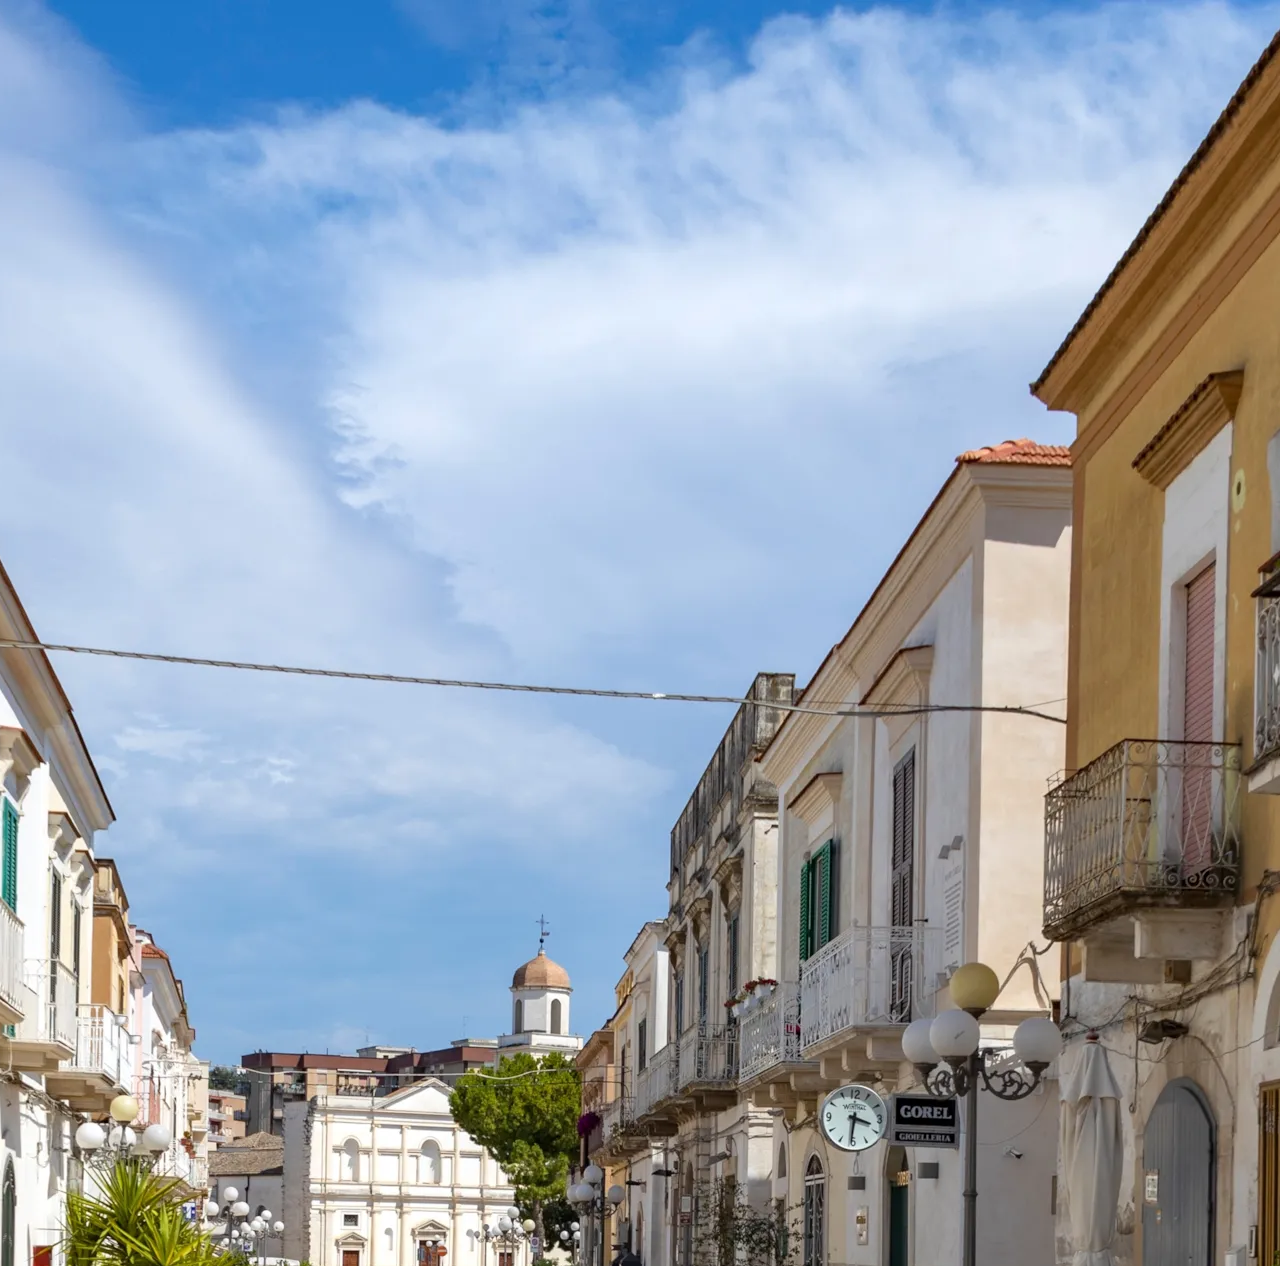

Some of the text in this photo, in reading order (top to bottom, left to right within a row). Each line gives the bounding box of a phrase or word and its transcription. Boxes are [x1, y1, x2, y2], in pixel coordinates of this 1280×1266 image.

[850, 1089, 861, 1100] 12
[825, 1112, 832, 1121] 9
[900, 1105, 952, 1120] GOREL
[876, 1115, 883, 1124] 3
[898, 1132, 951, 1142] GIOIELLERIA
